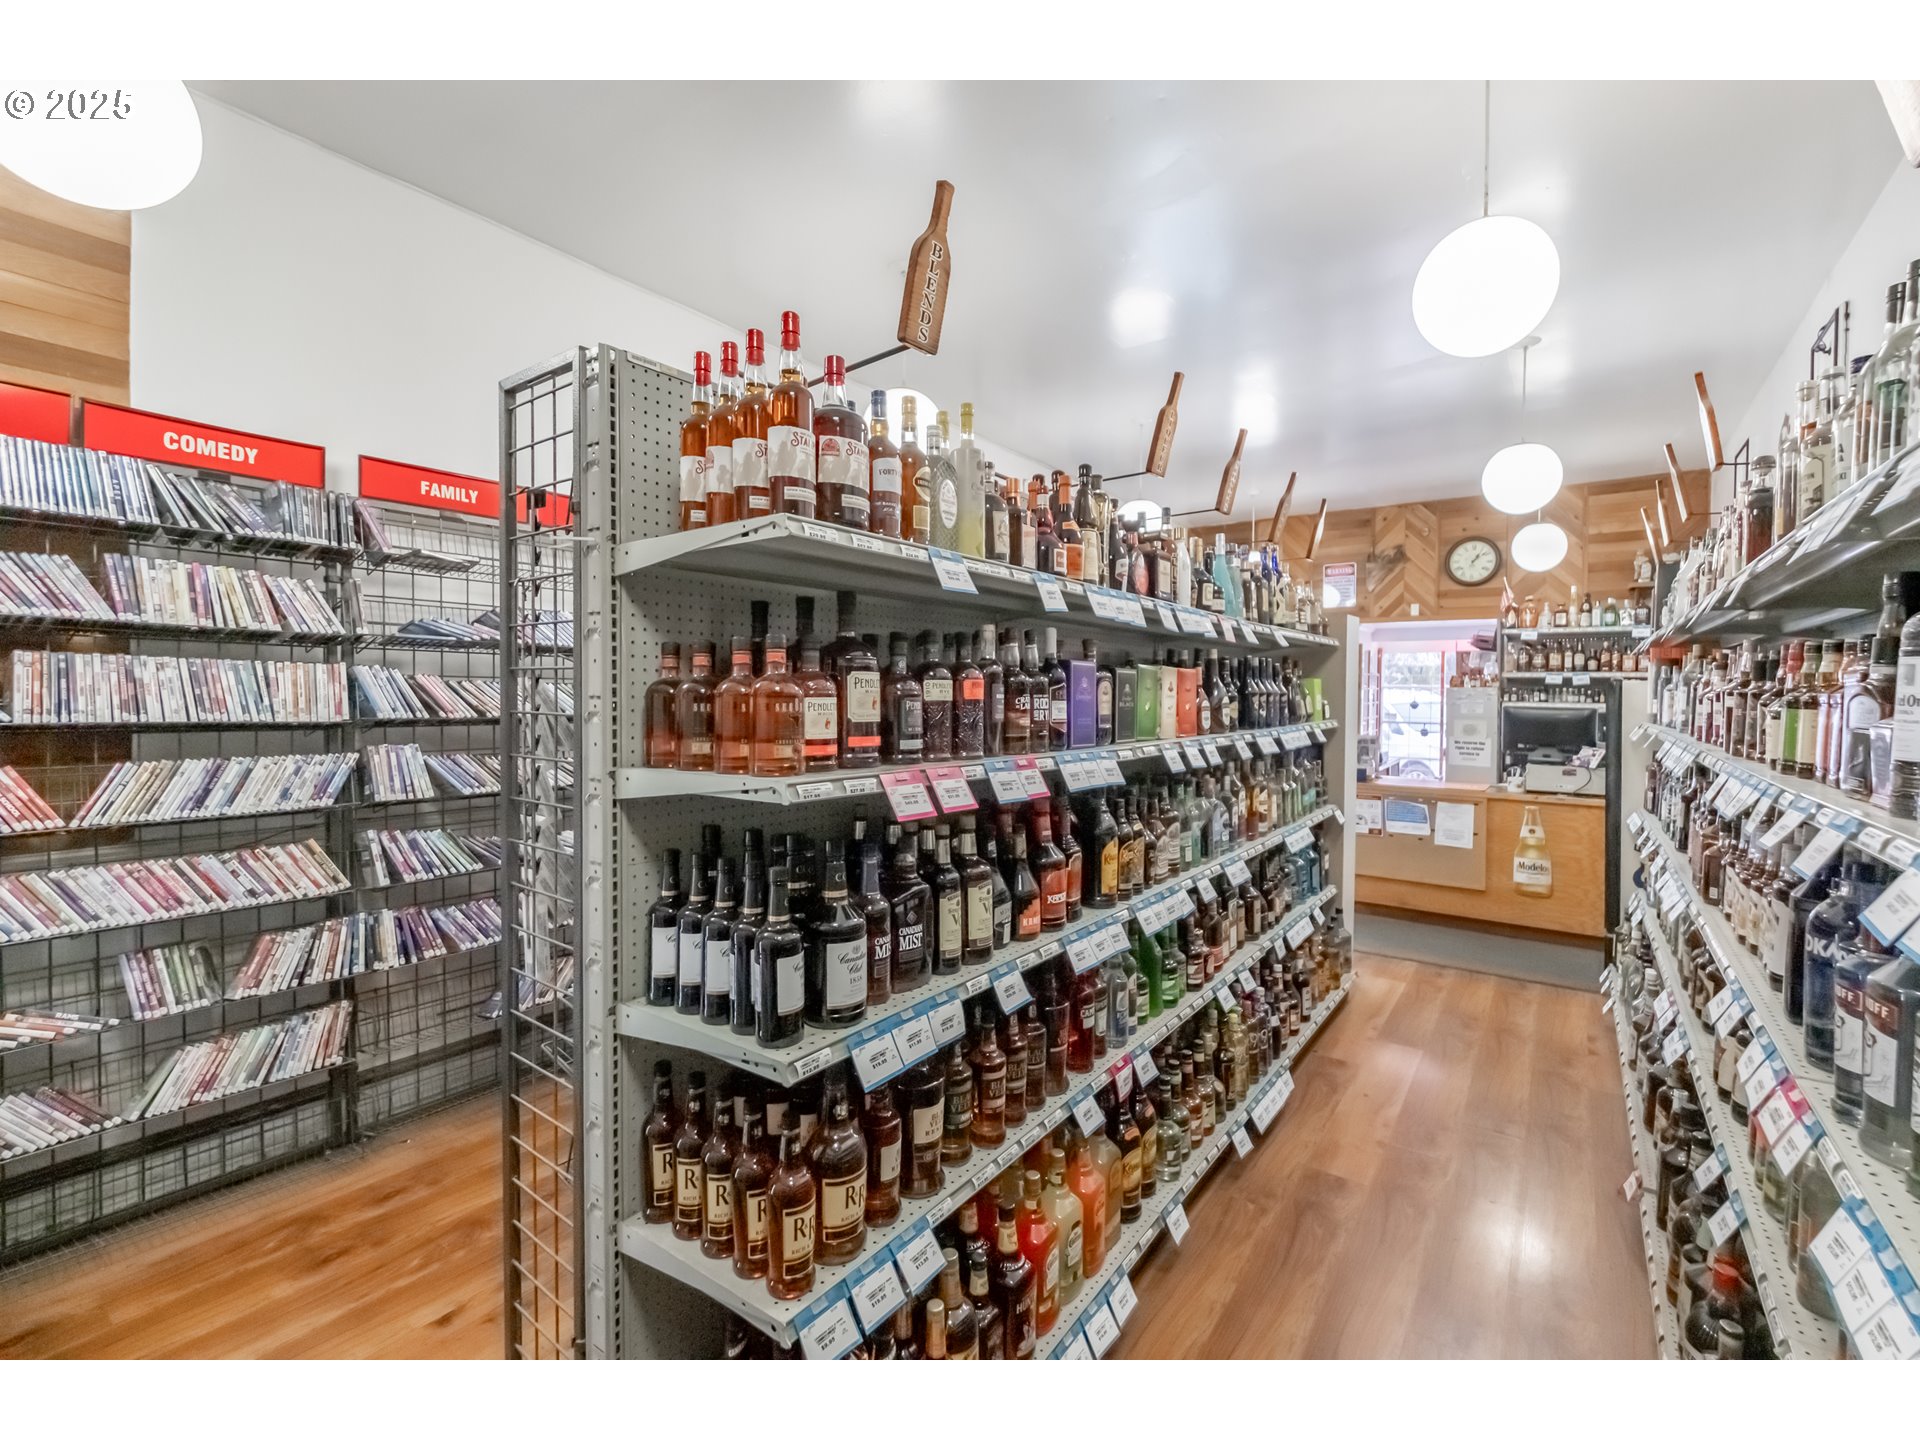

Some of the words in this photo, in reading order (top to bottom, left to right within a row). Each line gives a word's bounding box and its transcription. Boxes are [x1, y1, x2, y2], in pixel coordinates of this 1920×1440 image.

[918, 240, 944, 342] BLENDS
[163, 431, 259, 465] COMEDY
[420, 480, 479, 505] FAMILY
[1518, 861, 1549, 874] Modelo
[899, 923, 923, 936] CANADIAN
[899, 933, 923, 951] MIST
